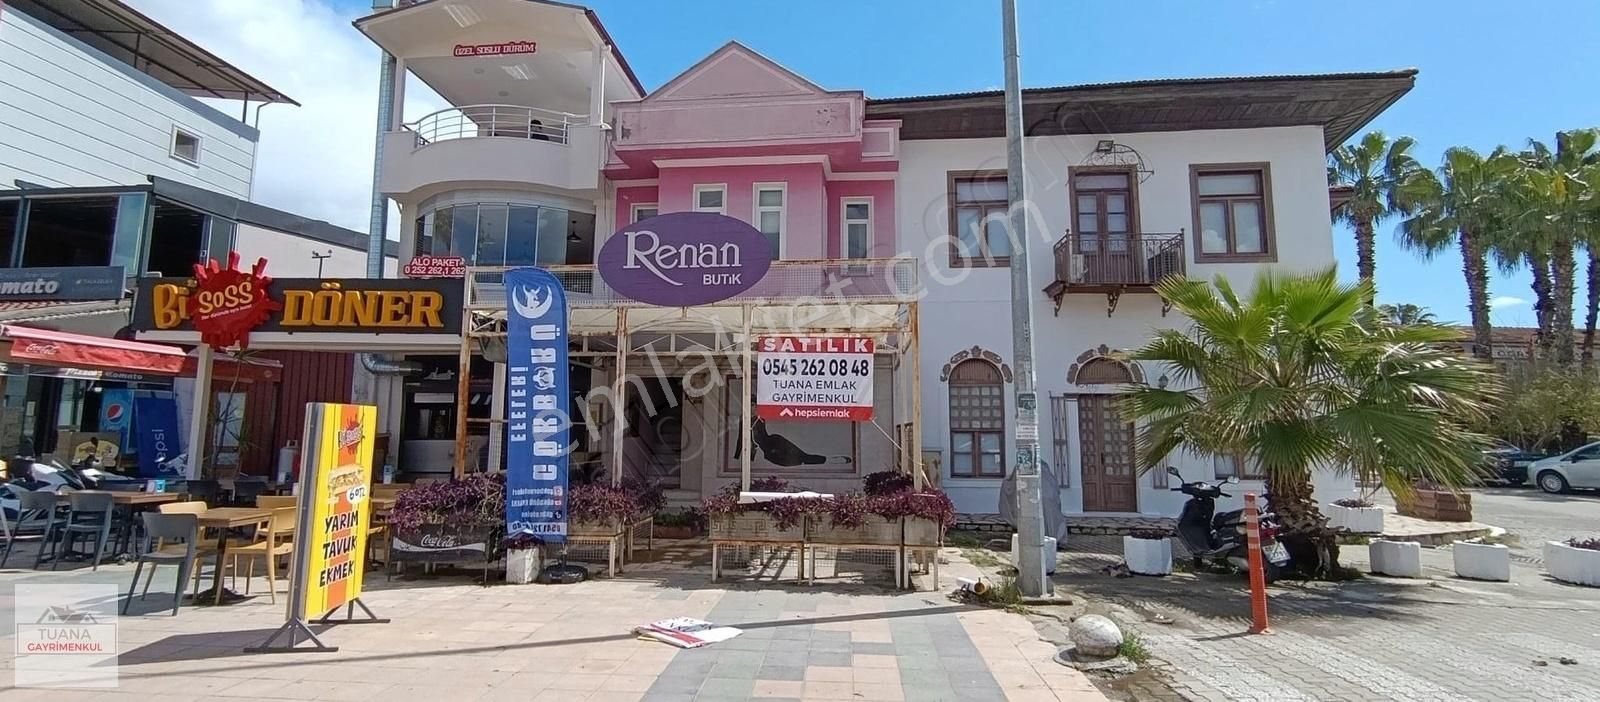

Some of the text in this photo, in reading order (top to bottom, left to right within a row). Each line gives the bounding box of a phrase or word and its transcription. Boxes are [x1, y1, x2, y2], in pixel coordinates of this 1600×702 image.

[455, 42, 535, 56] ÖZEL SOSLU DÜRÜM
[411, 257, 461, 267] ALO PAKET
[622, 230, 742, 286] Renan
[404, 265, 466, 275] 0 252 262 1 262
[0, 278, 59, 295] mato
[279, 281, 444, 328] DÖNER
[763, 337, 868, 353] SATILIK
[762, 358, 869, 377] 0545 262 08 48
[773, 380, 857, 391] TUANA EMLAK
[772, 391, 858, 404] GAYRİMENKUL
[794, 408, 850, 418] hepsiemlak
[324, 510, 359, 535] YARIM
[322, 535, 358, 561] TAVUK
[319, 560, 354, 588] EKMEK
